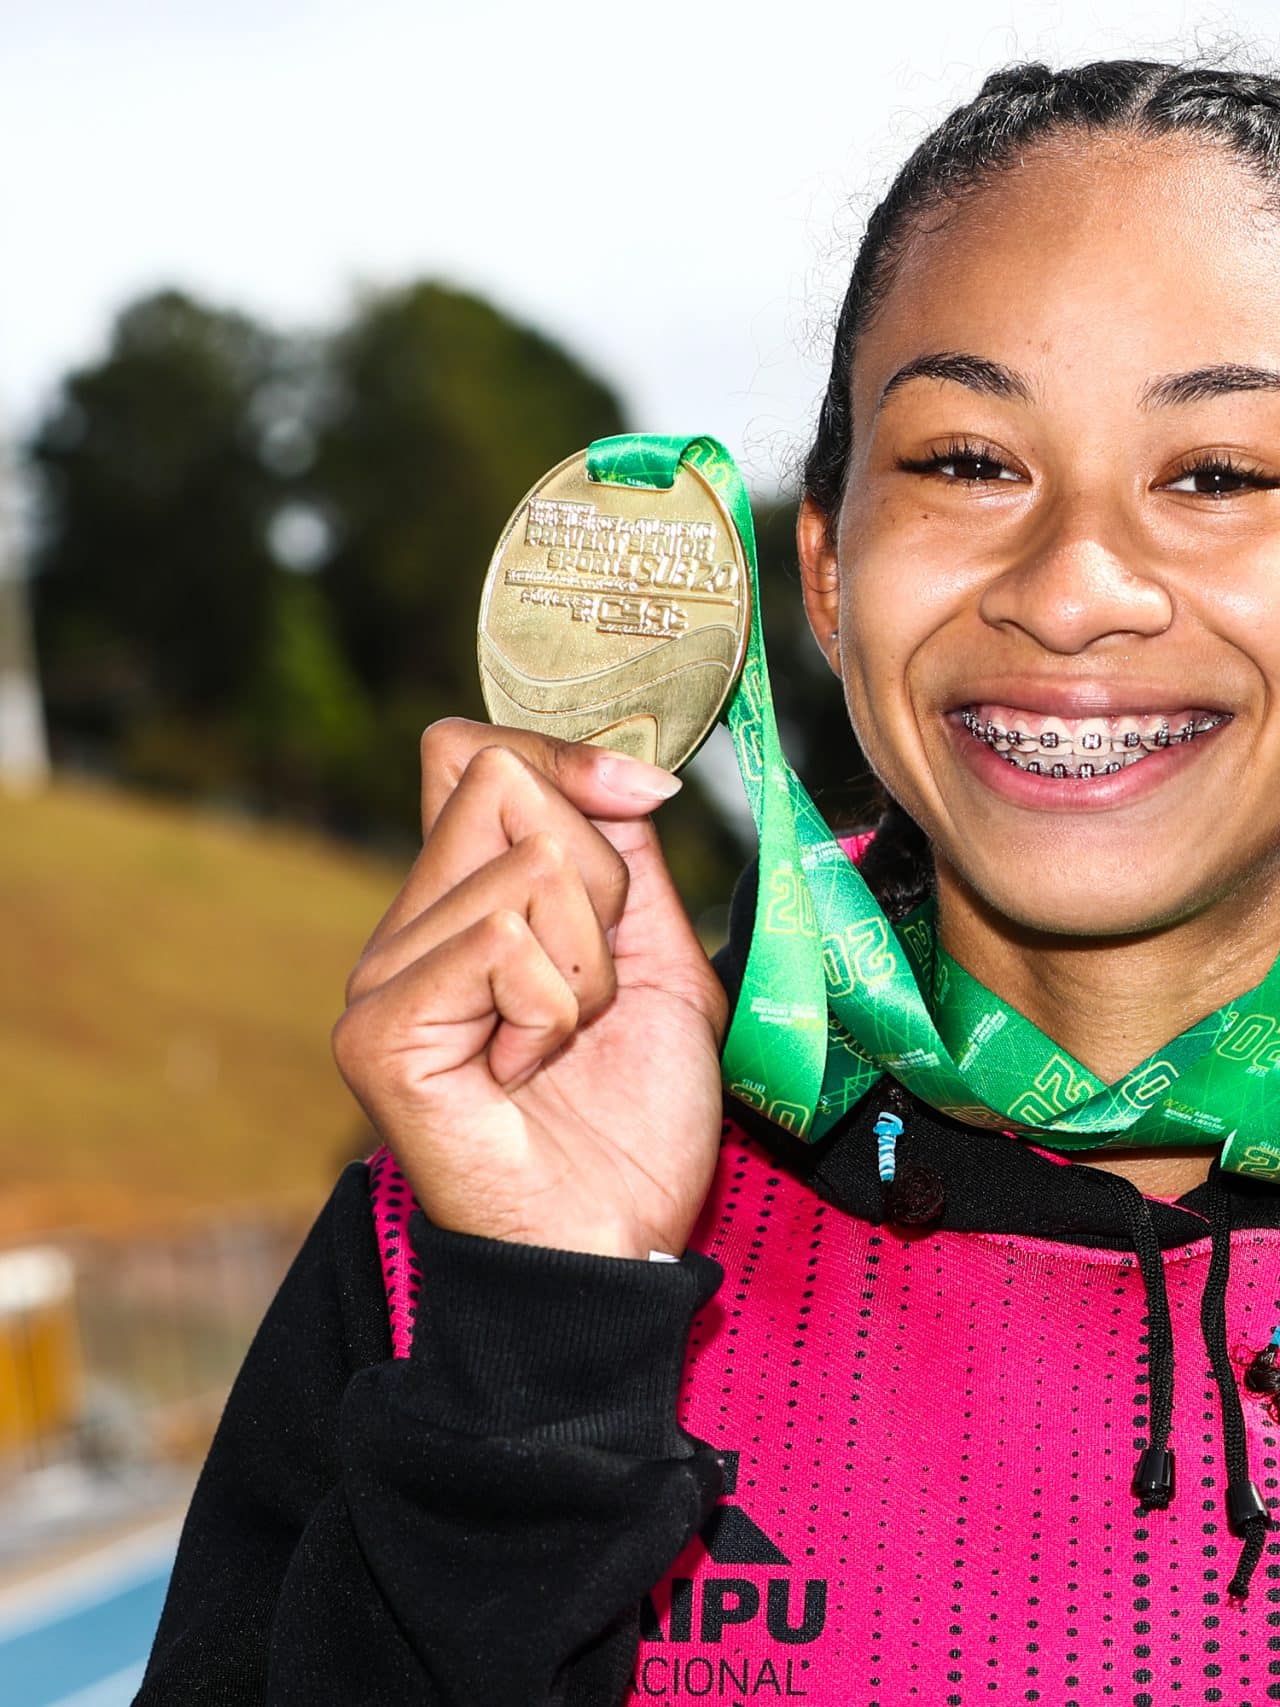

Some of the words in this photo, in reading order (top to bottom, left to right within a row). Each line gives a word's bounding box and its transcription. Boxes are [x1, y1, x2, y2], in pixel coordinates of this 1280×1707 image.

[525, 524, 629, 556] PREVENT
[629, 532, 715, 561] SENIOR
[547, 548, 639, 577] SPORTS
[632, 1656, 808, 1697] CIONAL
